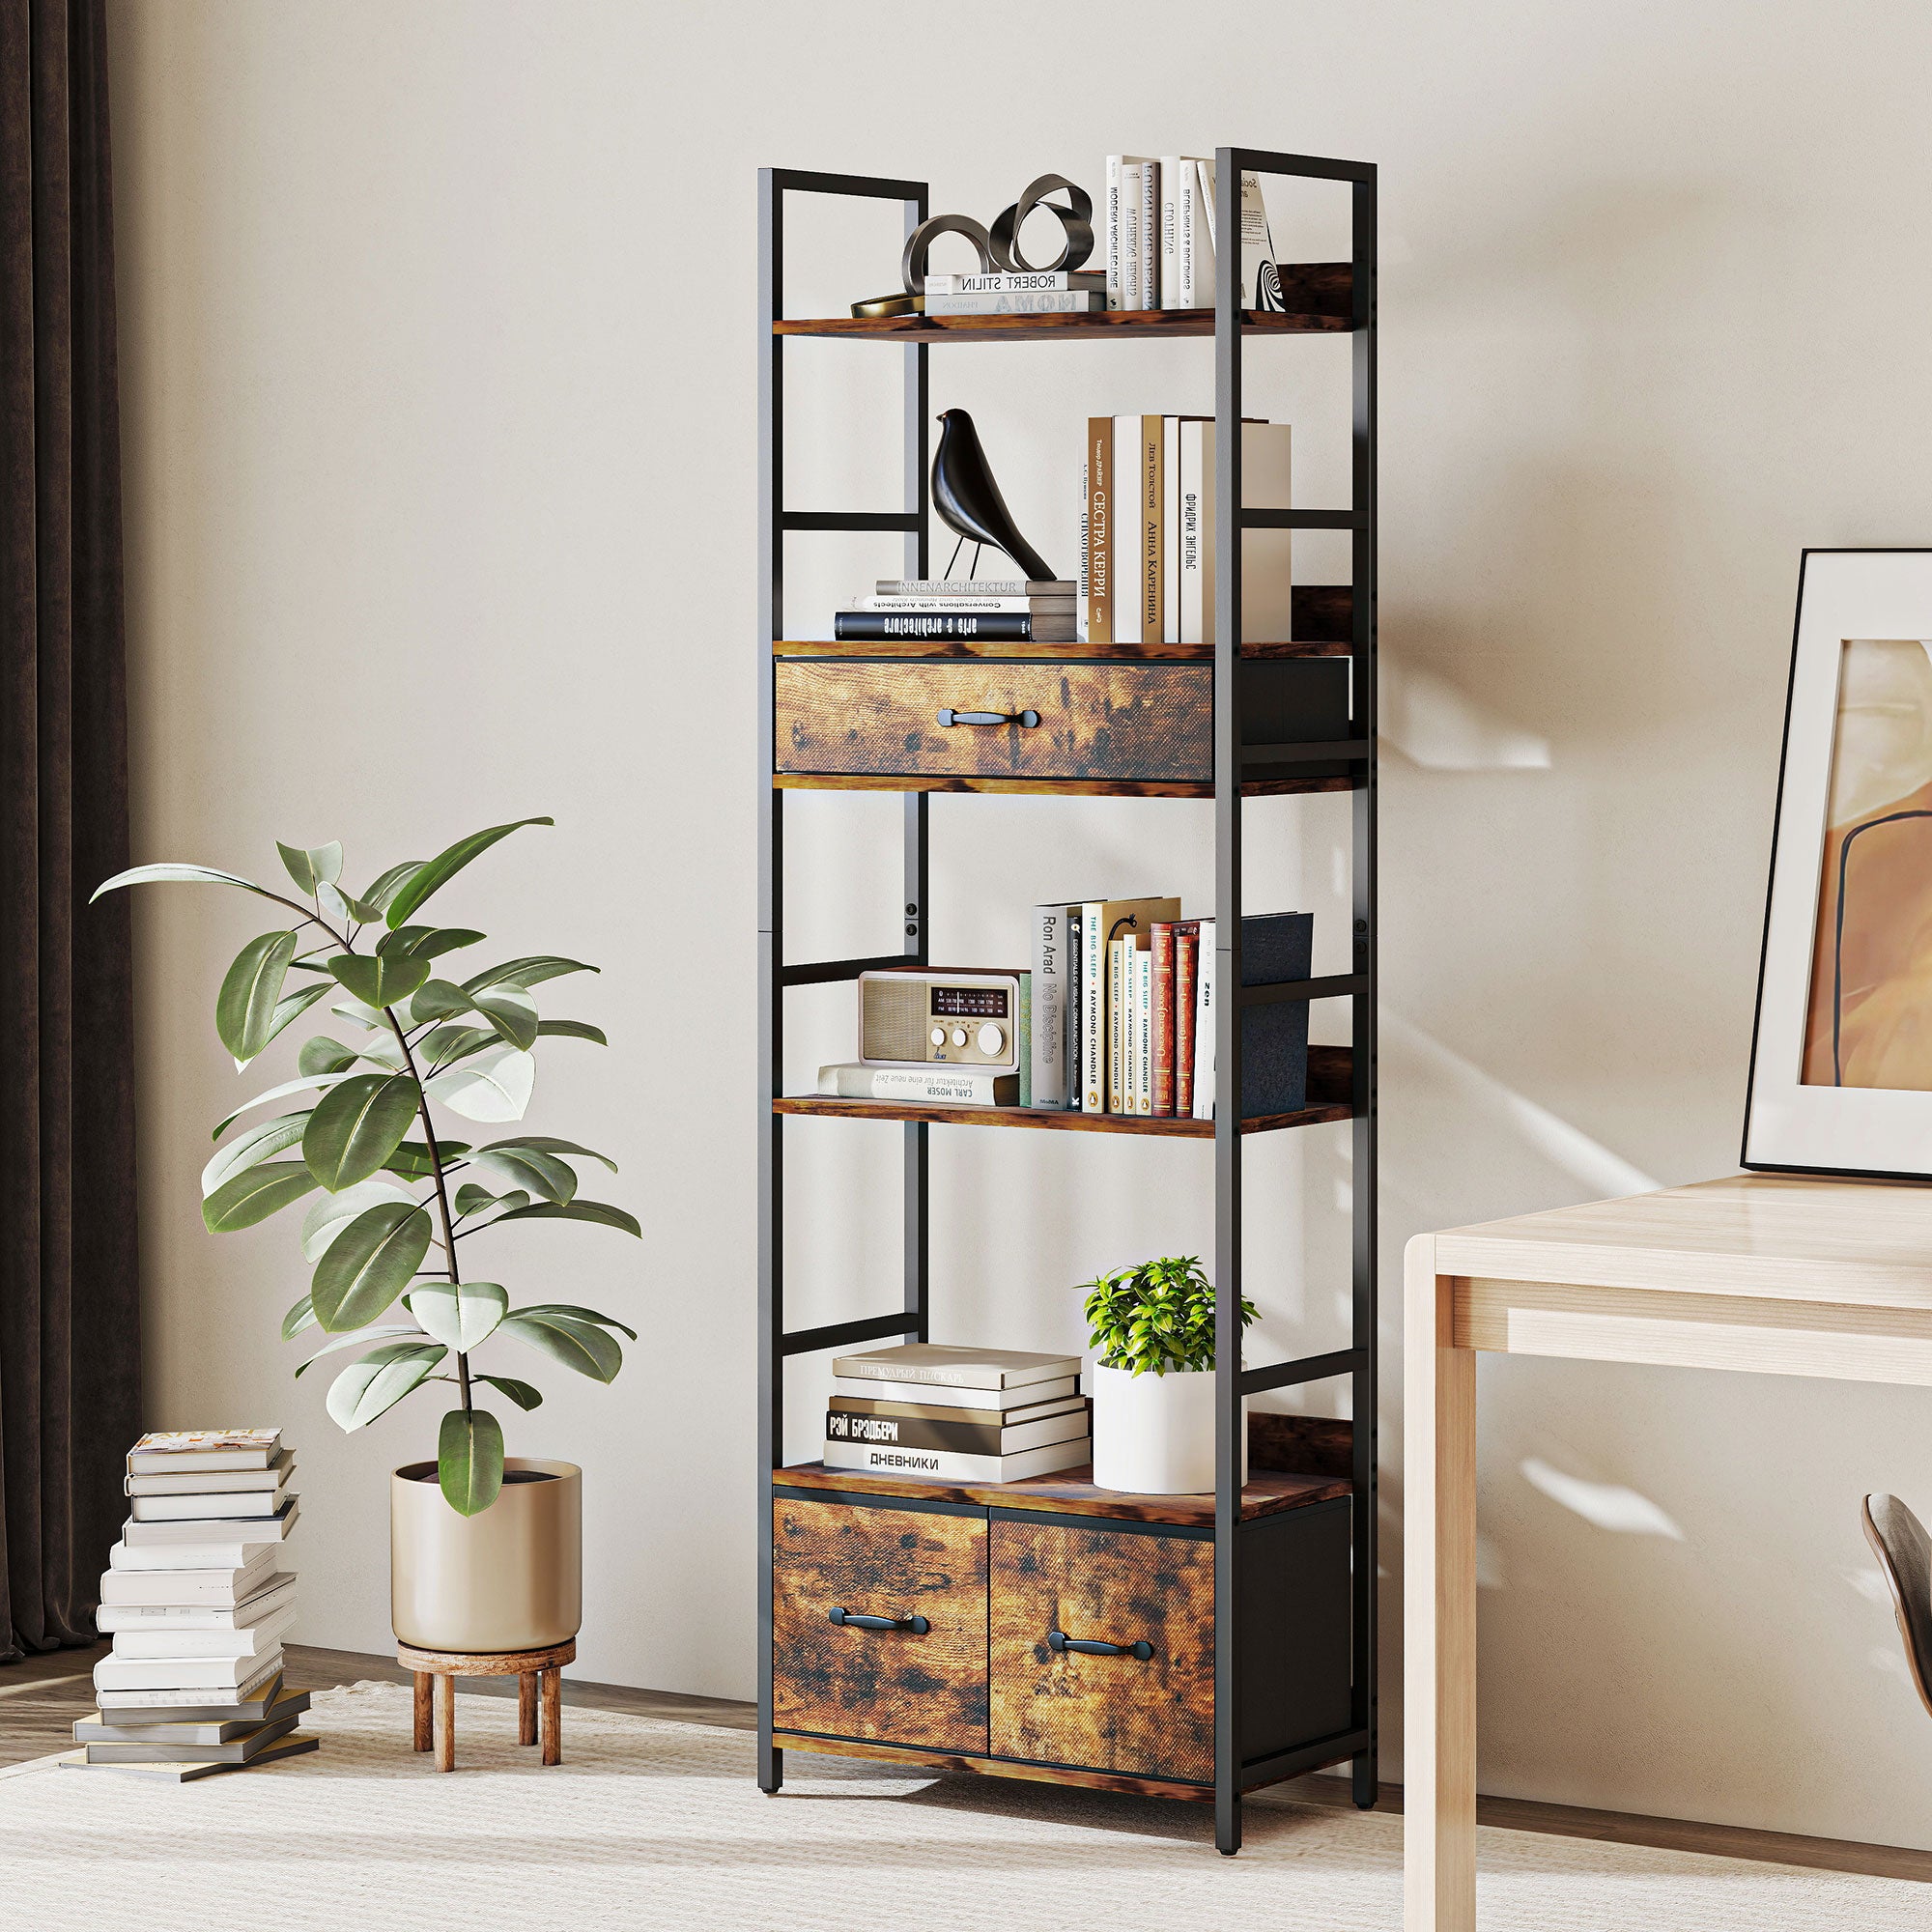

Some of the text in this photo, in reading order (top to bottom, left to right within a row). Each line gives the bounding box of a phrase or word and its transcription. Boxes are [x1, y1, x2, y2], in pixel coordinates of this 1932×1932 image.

[1094, 491, 1106, 547] СЕСТРА
[1148, 521, 1157, 556] АННА
[1185, 494, 1197, 570] ФРИДРИХ ЭНГЕЛЬС
[1094, 551, 1106, 597] КЕРРИ
[897, 582, 1016, 594] INNENARCHITEKTUR
[1148, 560, 1157, 624] КАРЕНИНА
[884, 618, 977, 637] arts & architecture
[1041, 916, 1057, 1064] Ron Arad No Discipline
[876, 1074, 889, 1083] Zeit
[909, 1077, 923, 1085] eine
[924, 1078, 934, 1086] für
[936, 1078, 973, 1088] Architektur
[927, 1087, 972, 1097] CARL MOSER
[860, 1364, 916, 1379] ПРЕМУДРЫЙ
[830, 1414, 898, 1441] РЭЙ БРЭДБЕРИ
[870, 1453, 939, 1470] ДНЕВНИКИ
